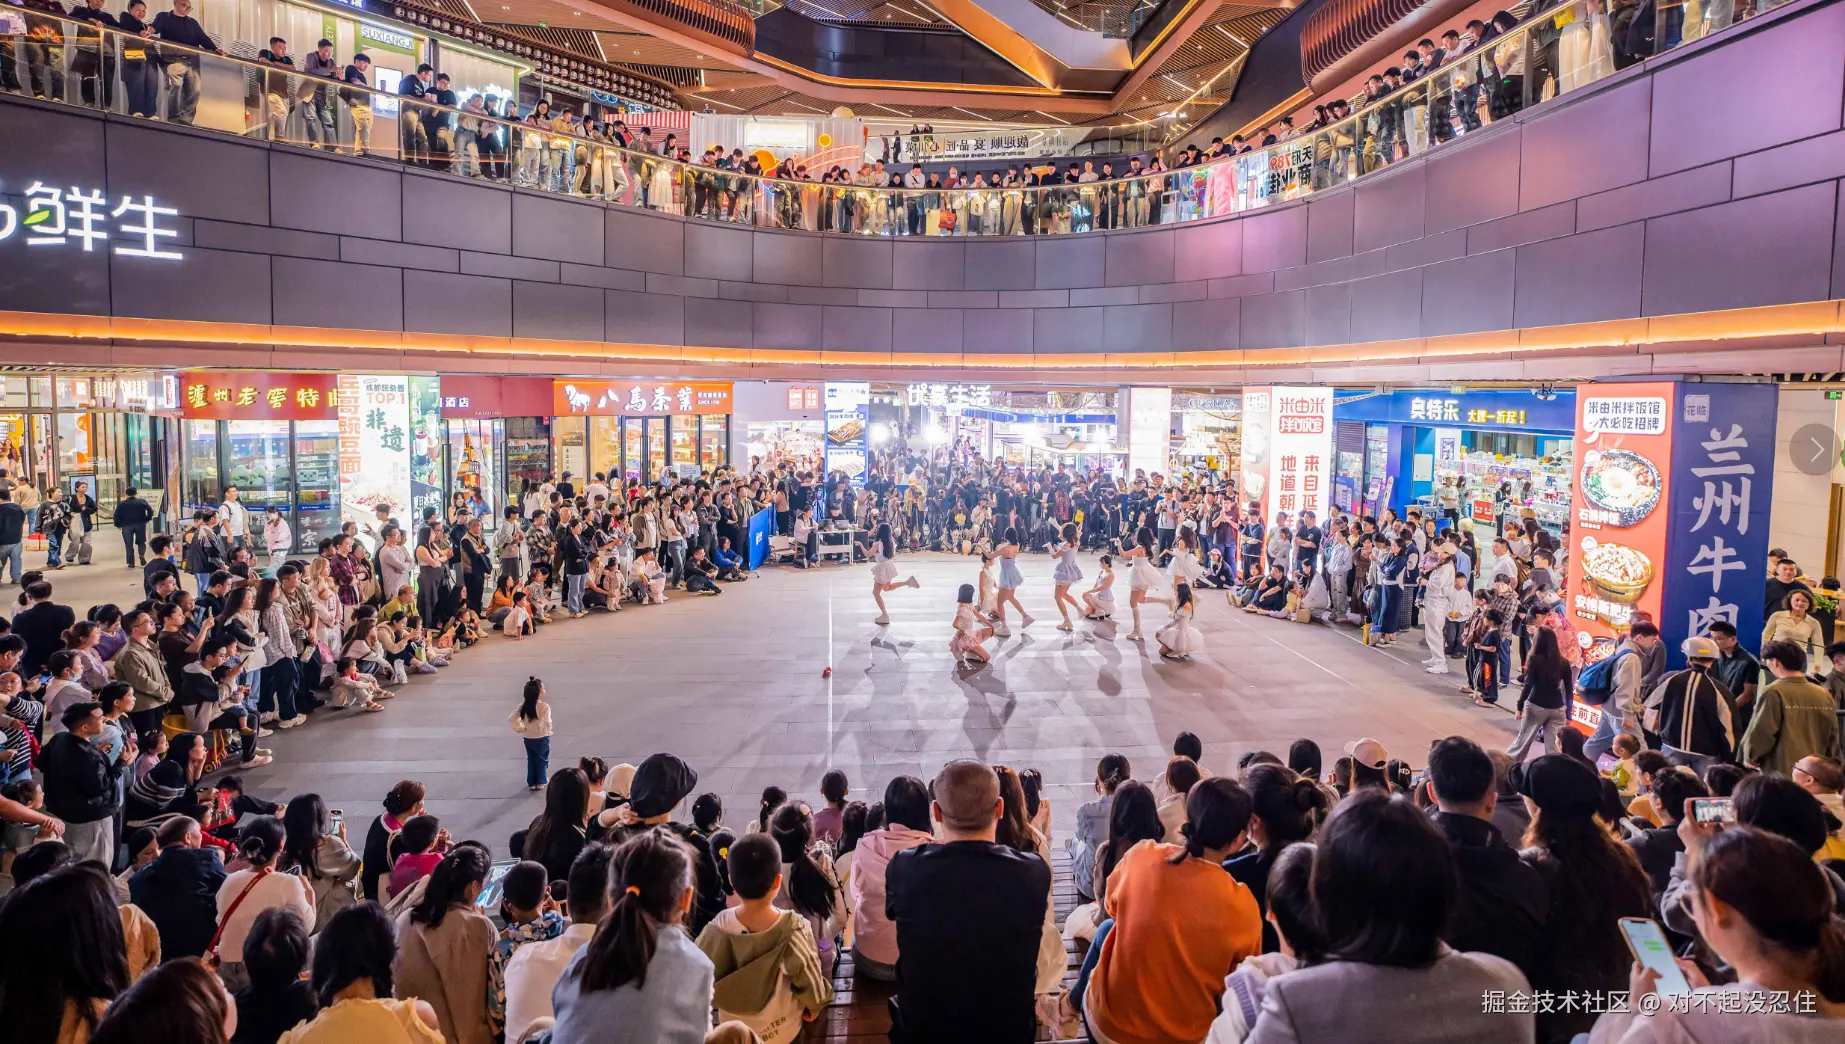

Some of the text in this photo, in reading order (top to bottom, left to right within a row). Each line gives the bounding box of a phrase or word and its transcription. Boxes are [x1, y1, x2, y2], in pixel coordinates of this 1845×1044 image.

[24, 181, 183, 260] 鲜生
[440, 396, 469, 408] 酒店
[1280, 397, 1325, 414] 米由米
[1411, 397, 1460, 421] 奥特乐
[1588, 401, 1660, 415] 米由米拌饭馆
[1590, 416, 1660, 430] 大必吃招牌
[1302, 455, 1320, 522] 来自延
